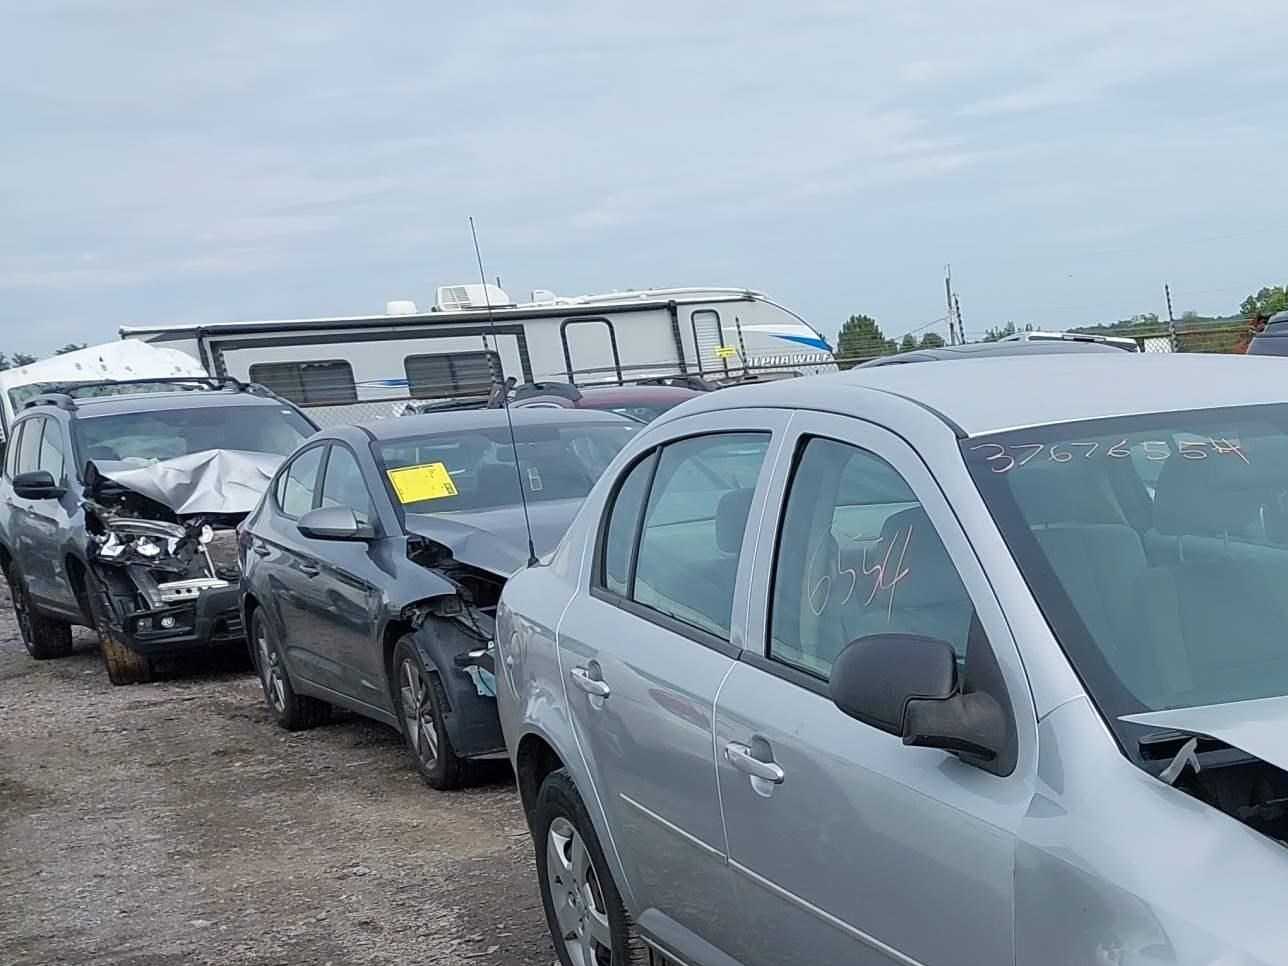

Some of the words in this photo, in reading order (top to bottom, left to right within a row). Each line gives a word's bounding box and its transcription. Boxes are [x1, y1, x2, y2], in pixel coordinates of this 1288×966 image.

[794, 353, 832, 363] WOLF
[970, 437, 1251, 473] 37676554
[806, 523, 913, 625] 6554
